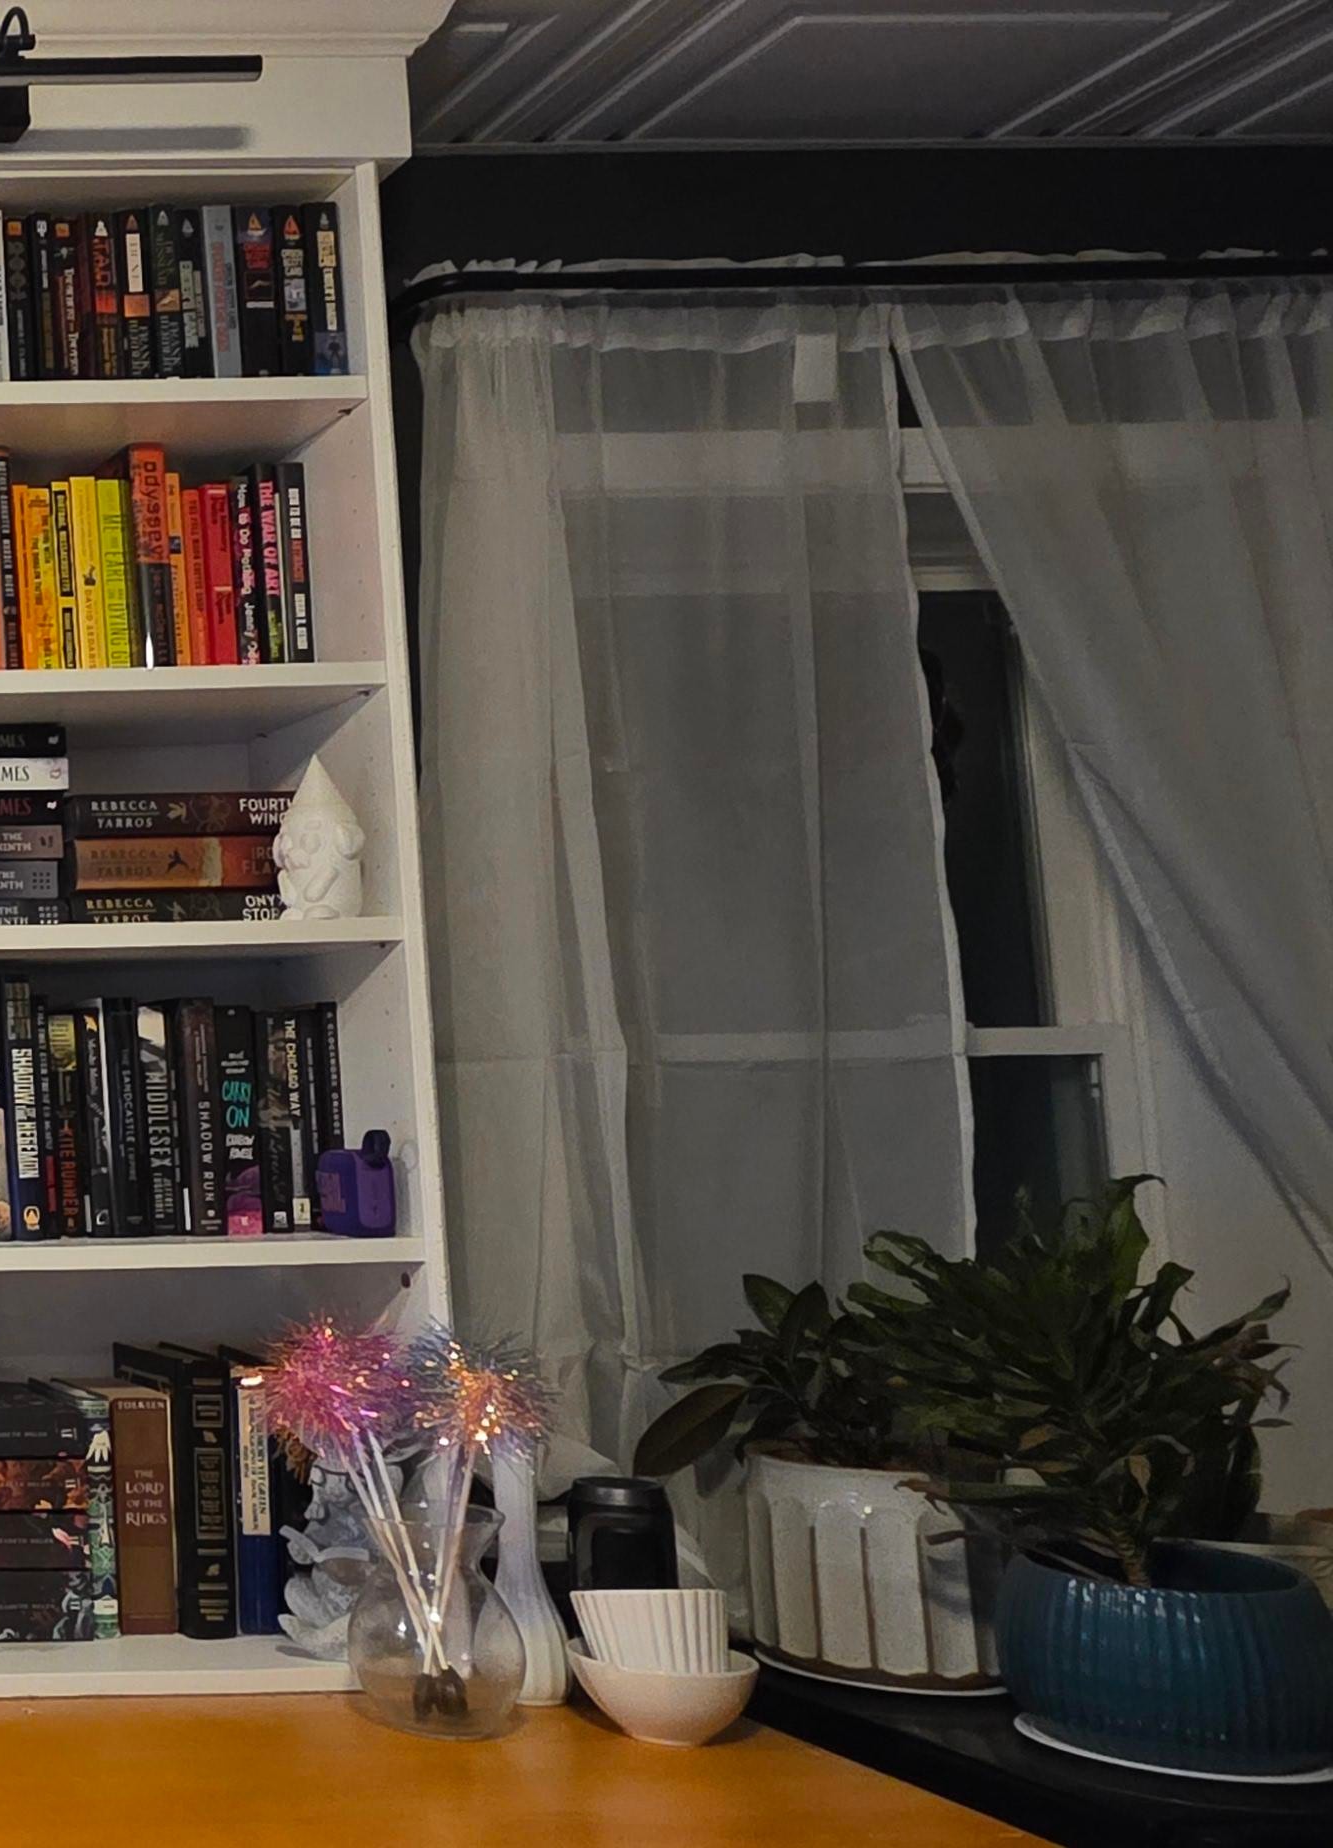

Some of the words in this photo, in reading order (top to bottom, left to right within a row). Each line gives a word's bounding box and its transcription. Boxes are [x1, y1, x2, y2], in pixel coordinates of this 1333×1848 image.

[259, 482, 273, 506] THE
[261, 510, 276, 543] WAR
[263, 547, 276, 565] OF
[266, 569, 279, 596] ART
[244, 603, 255, 637] Jenny
[91, 801, 157, 811] REBECCA
[98, 818, 152, 828] YARROS
[87, 899, 153, 909] REBECCA
[11, 1048, 34, 1104] SHADOW
[146, 1072, 171, 1167] MIDDLESEX
[199, 1101, 212, 1164] SHADOW
[203, 1171, 213, 1201] RUN
[125, 1482, 164, 1495] LORD
